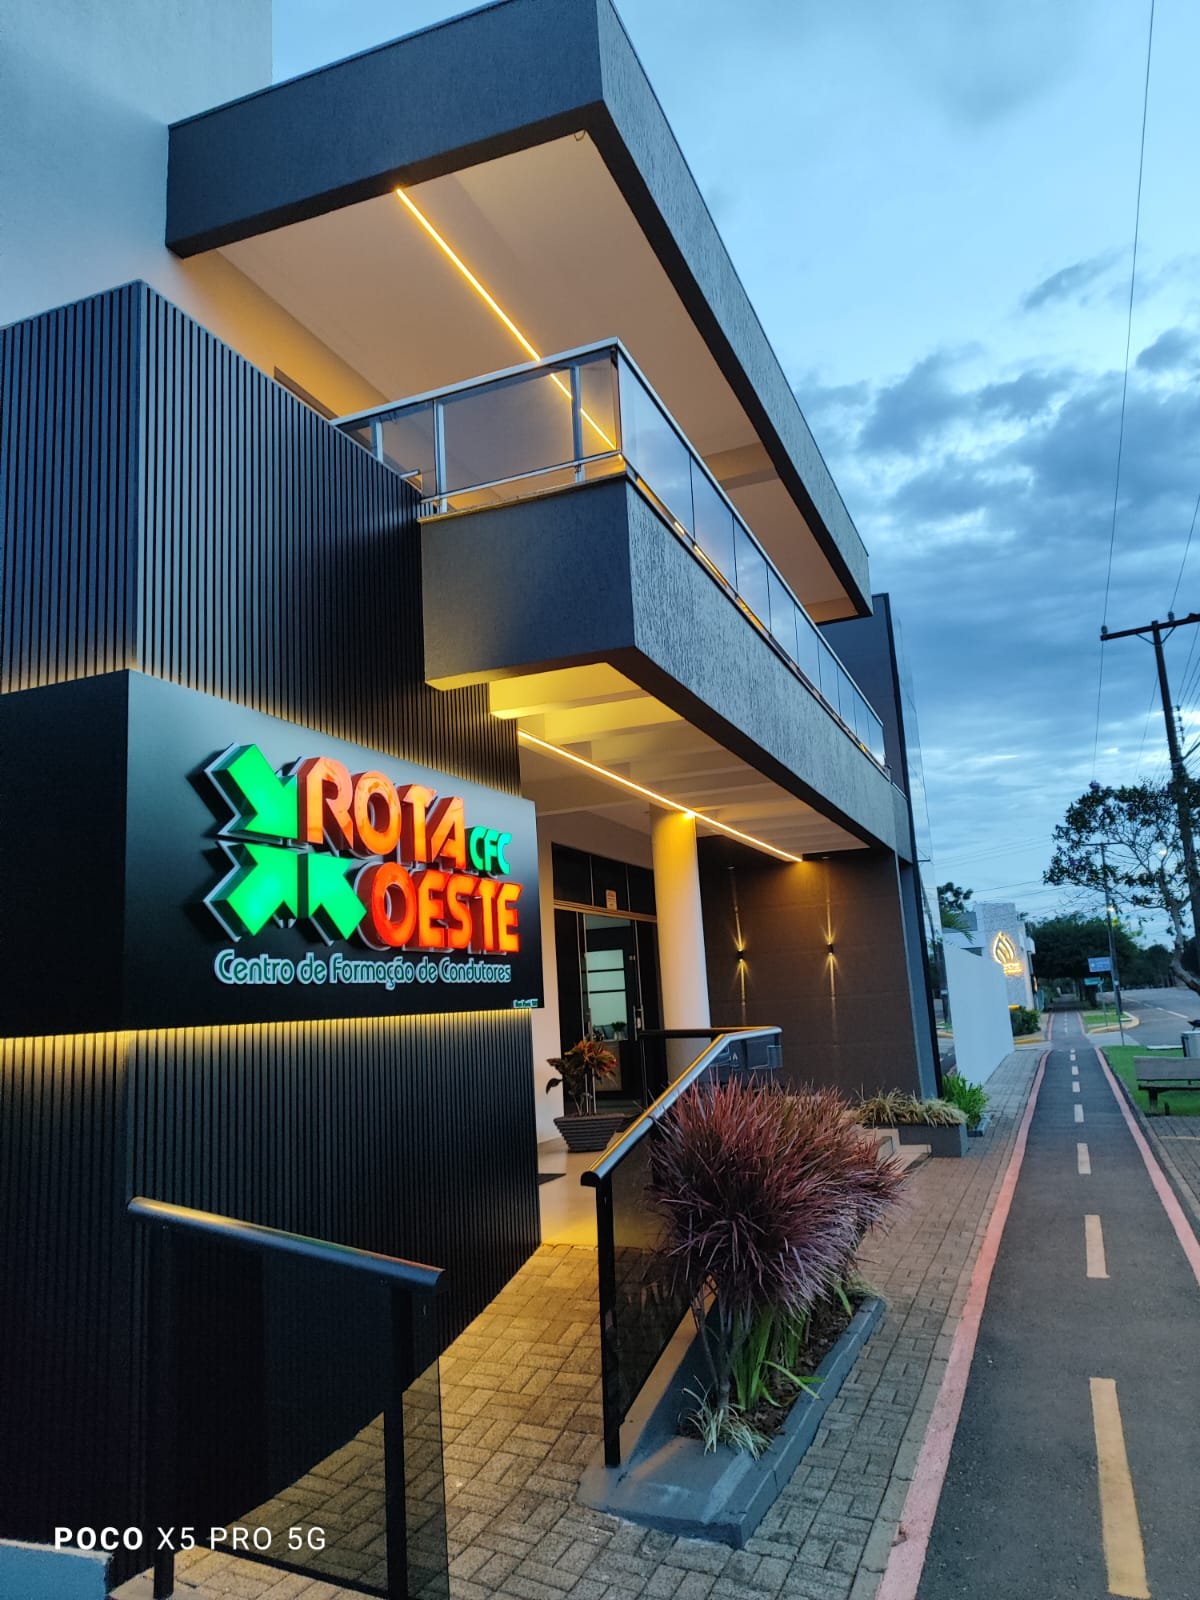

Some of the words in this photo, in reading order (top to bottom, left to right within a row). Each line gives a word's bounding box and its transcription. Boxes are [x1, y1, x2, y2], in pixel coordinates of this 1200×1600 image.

[303, 757, 467, 870] ROTA
[469, 826, 512, 875] CFC
[368, 862, 524, 953] OESTE
[214, 949, 294, 984] Centro
[297, 952, 327, 984] de
[329, 952, 415, 990] Formação
[416, 956, 438, 984] de
[439, 957, 512, 984] Condutores
